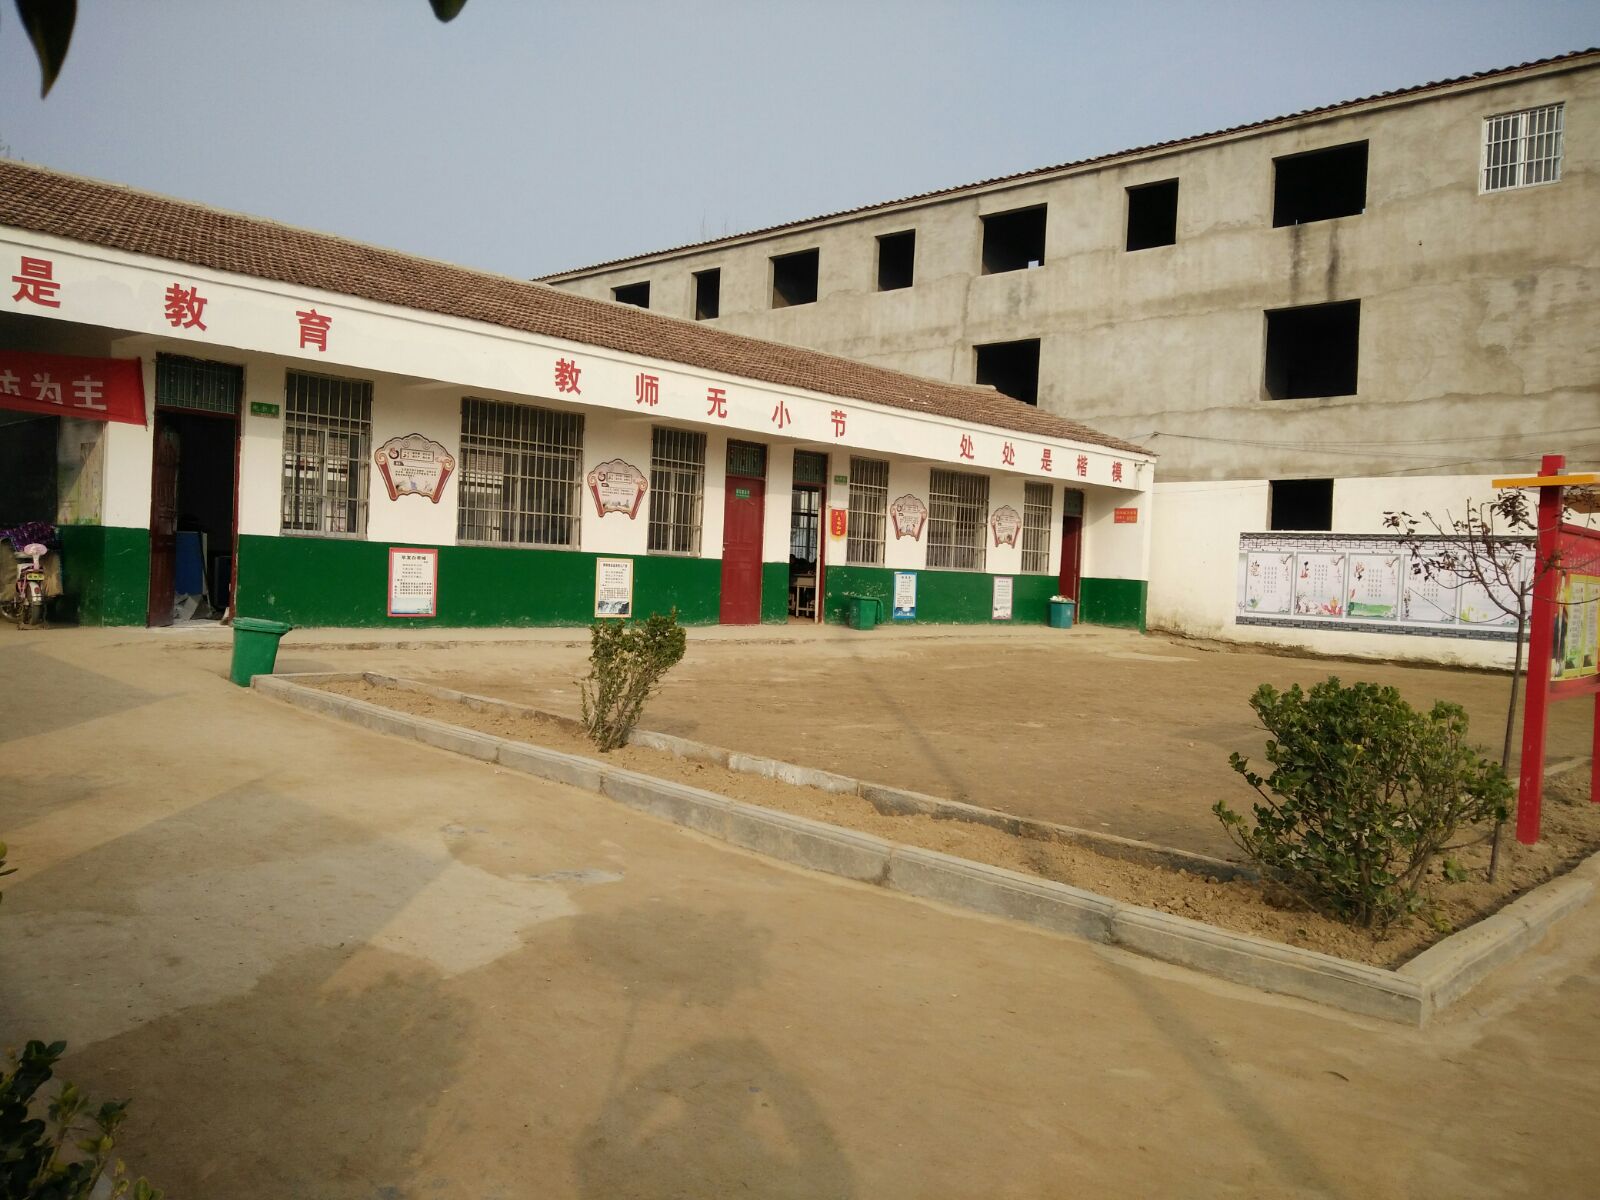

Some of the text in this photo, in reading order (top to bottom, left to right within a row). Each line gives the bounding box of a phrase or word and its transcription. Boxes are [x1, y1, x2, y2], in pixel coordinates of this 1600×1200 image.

[554, 358, 848, 438] 教师无小节
[959, 433, 1124, 484] 处处是楷模
